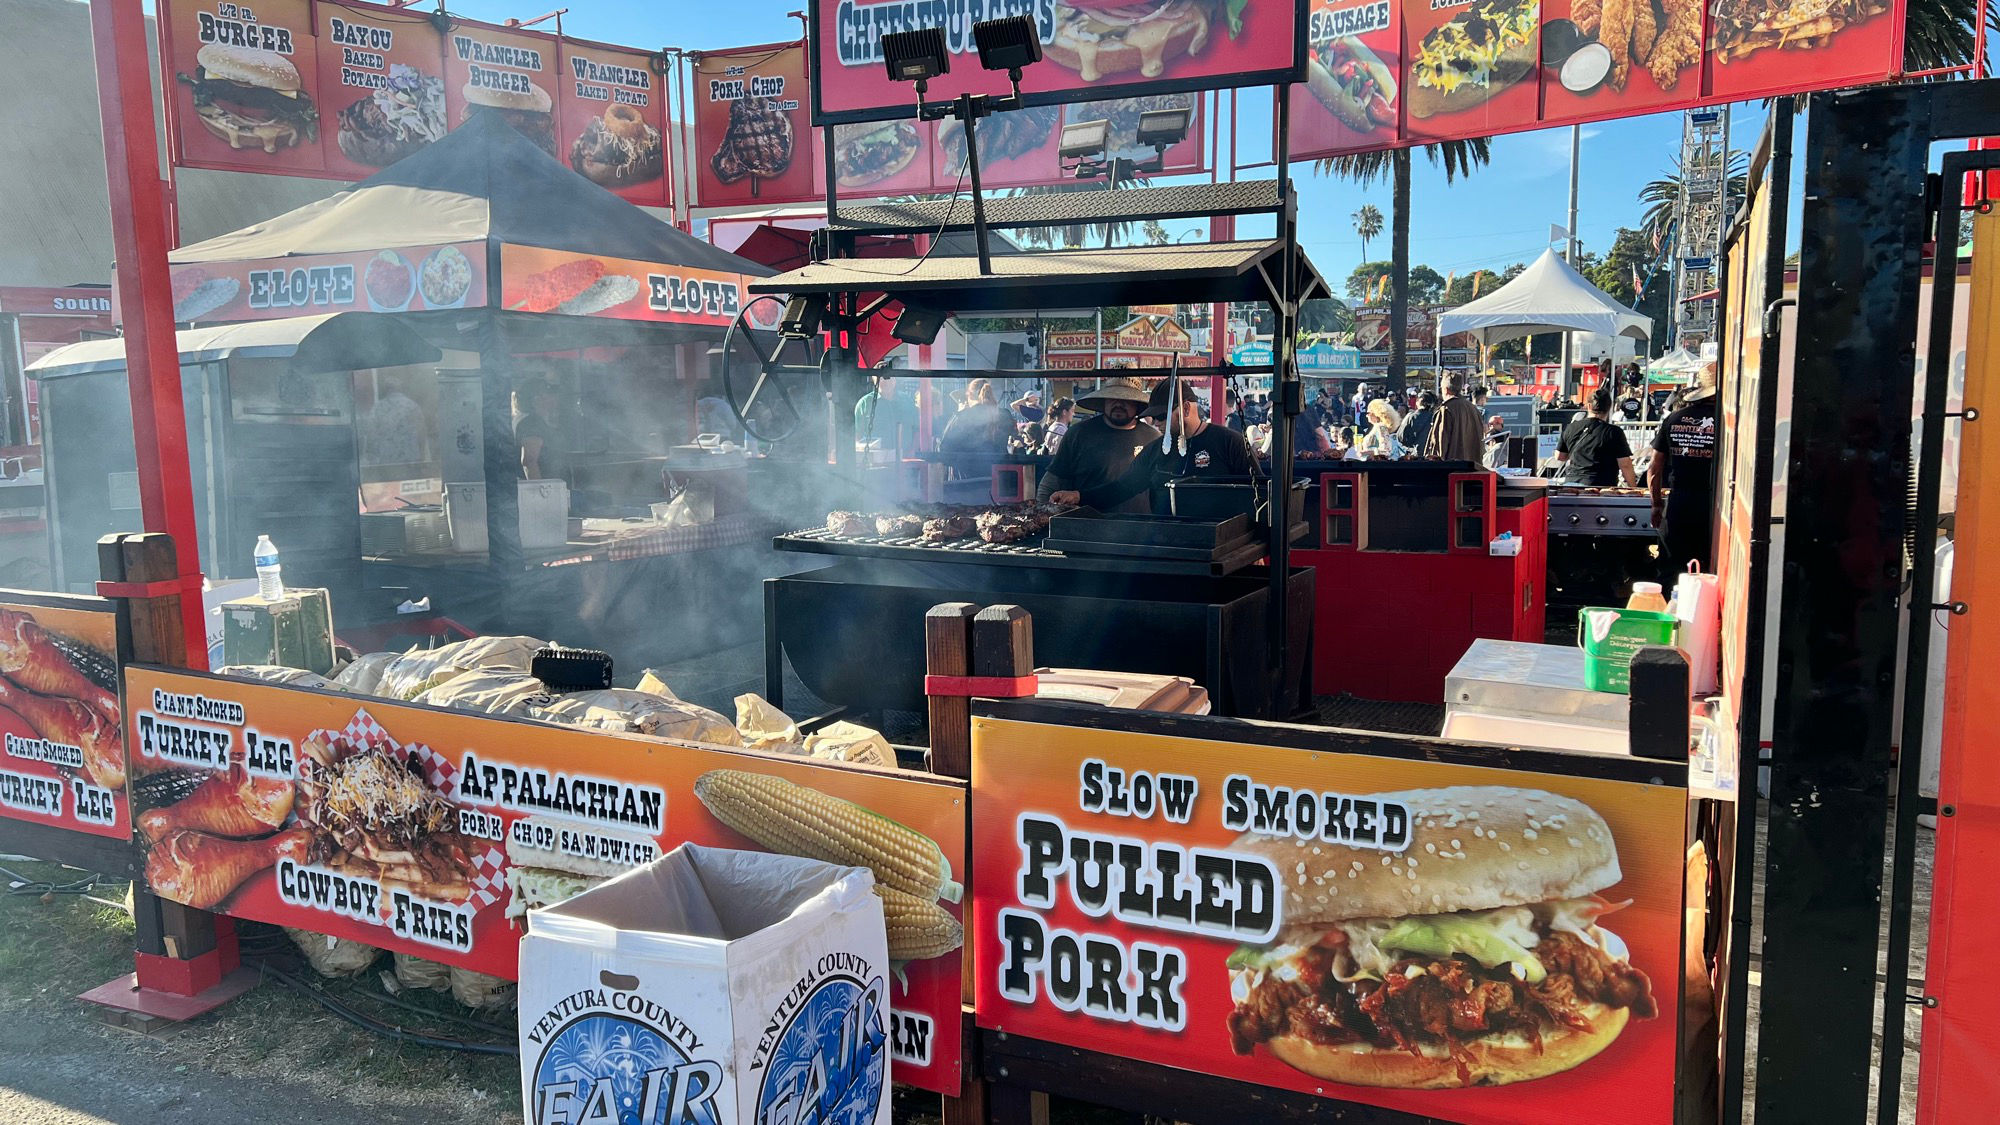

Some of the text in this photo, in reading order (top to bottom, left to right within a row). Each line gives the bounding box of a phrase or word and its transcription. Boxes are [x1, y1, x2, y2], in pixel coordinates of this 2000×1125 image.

[198, 13, 293, 54] BURGER
[332, 18, 392, 50] BAYOU
[1310, 4, 1389, 41] SAUSAGE
[343, 48, 384, 70] BAKED
[454, 36, 542, 71] WRANGLER
[571, 57, 649, 89] WRANGLER
[342, 68, 388, 90] POTATO
[469, 65, 531, 94] BURGER
[576, 82, 648, 106] BAKED POTATO
[710, 75, 784, 101] PORK CHOP
[250, 264, 354, 307] ELOTE
[648, 273, 738, 316] ELOTE
[1056, 336, 1082, 346] CORN
[1051, 360, 1093, 369] JUMBO
[153, 688, 244, 725] GIANT SMOKED
[5, 732, 83, 768] GIANT SMOKED
[139, 713, 294, 778] TURKEY LEG
[0, 770, 115, 825] URKEY LEG
[460, 754, 663, 833] APPALACHIAN
[1082, 759, 1412, 852] SLOW SMOKED
[460, 811, 655, 864] PORK CHOP SANDWICH
[1018, 812, 1281, 943] PULLED
[279, 858, 470, 951] COWBOY FRIES
[1000, 907, 1186, 1032] PORK
[528, 989, 704, 1054] VENTURA COUNTY
[750, 952, 872, 1072] VENTURA COUNTY
